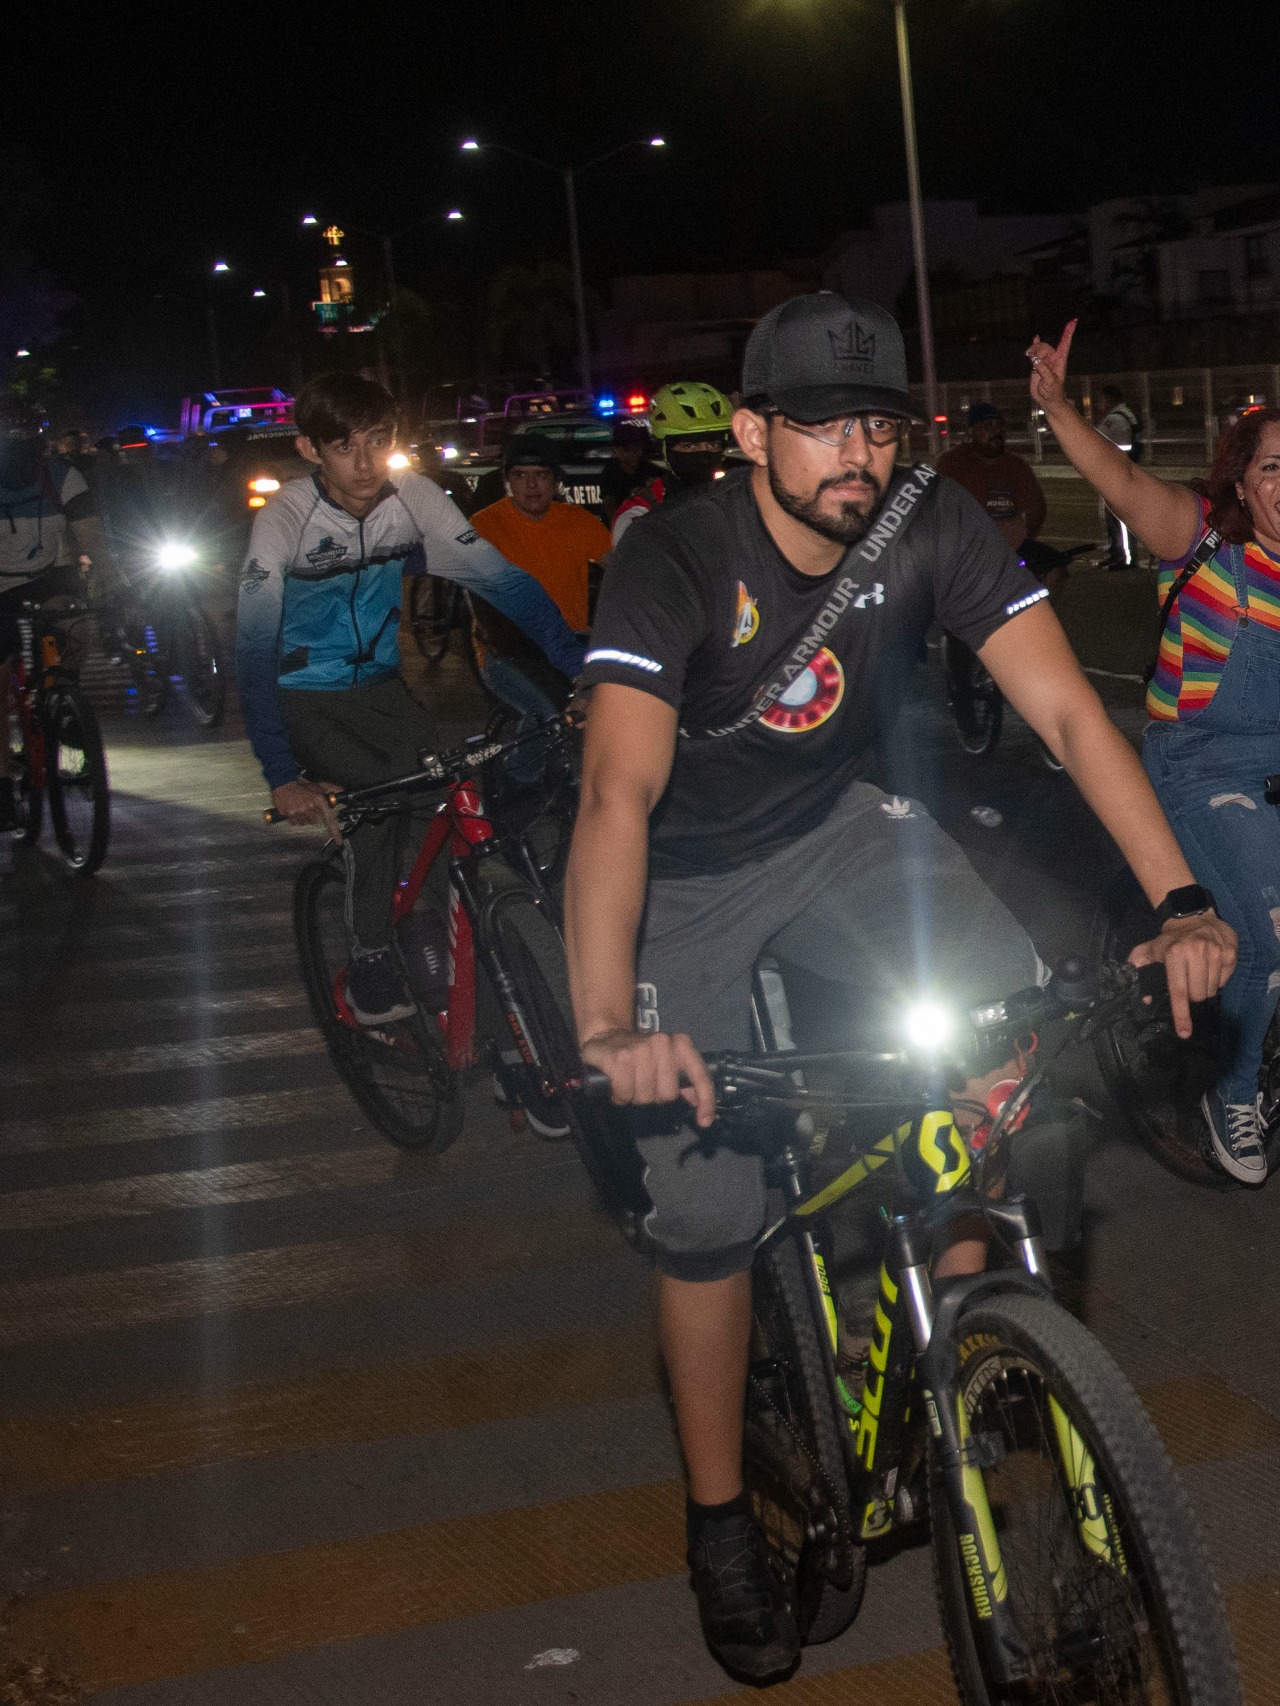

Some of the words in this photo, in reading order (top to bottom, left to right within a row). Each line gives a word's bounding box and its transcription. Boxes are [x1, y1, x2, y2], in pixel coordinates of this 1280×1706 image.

[706, 682, 787, 737] UNDER
[783, 577, 860, 682] ARMOUR
[860, 483, 923, 562] UNDER
[959, 1533, 993, 1620] ROCKSHOX
